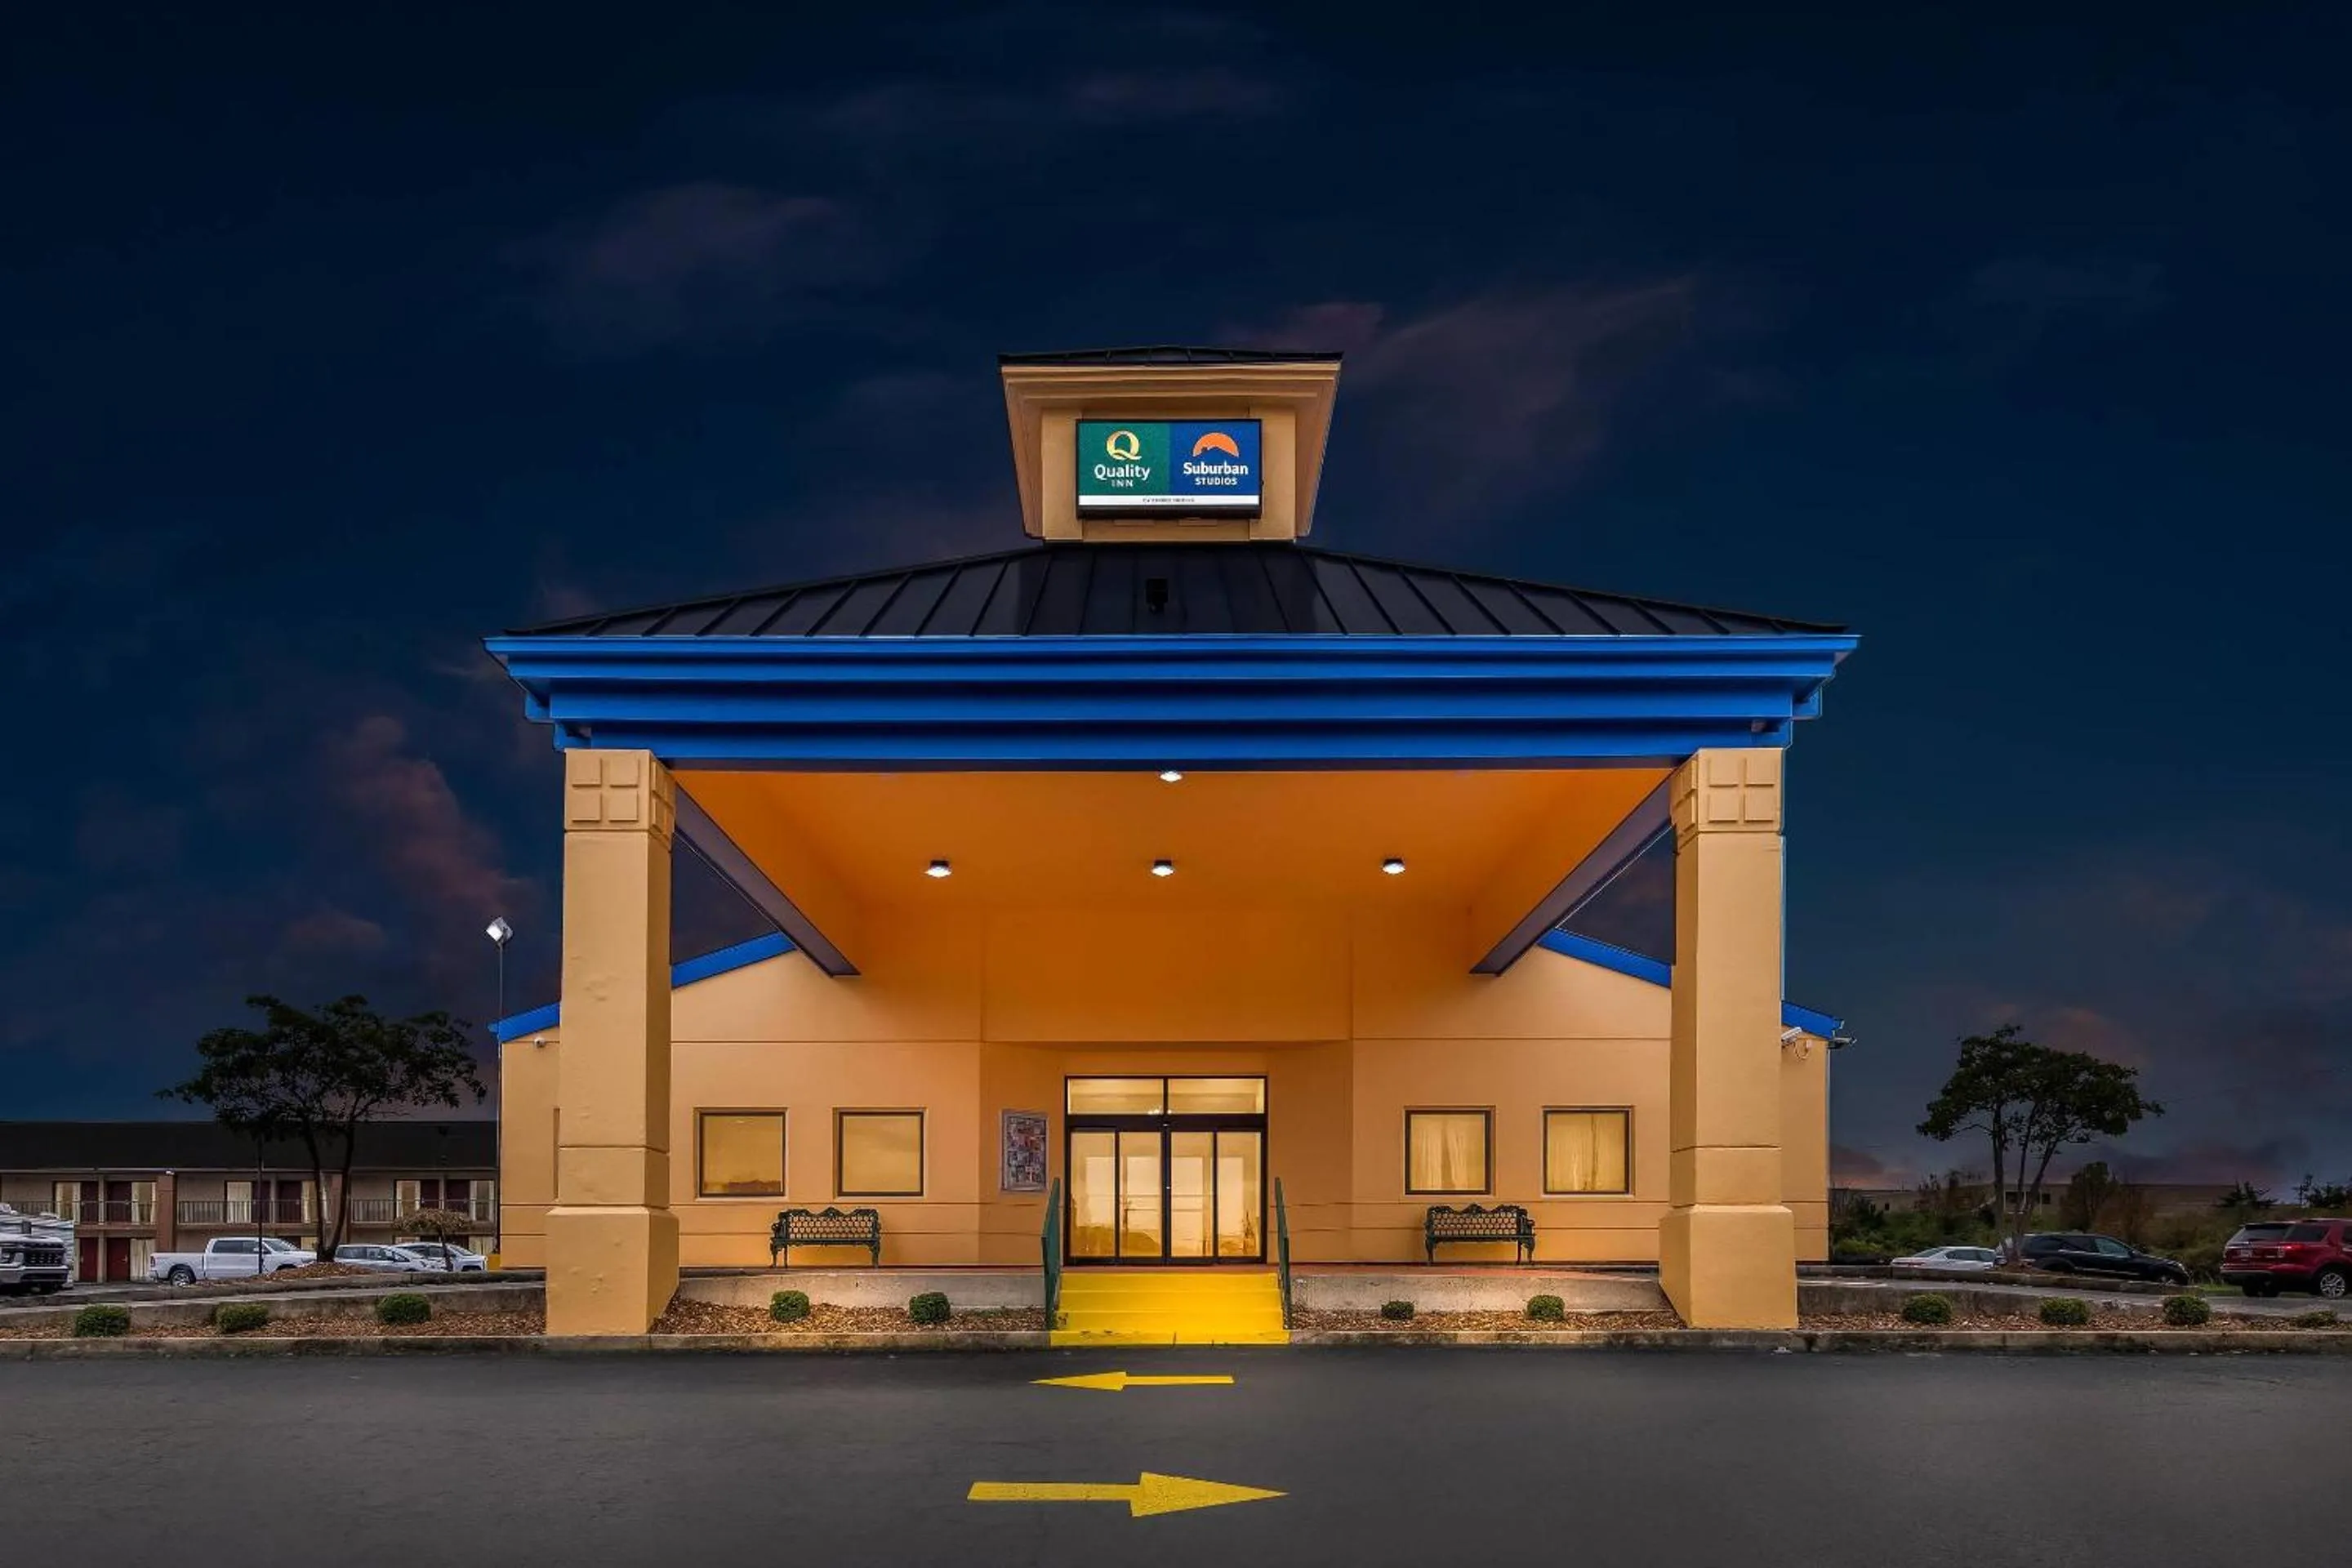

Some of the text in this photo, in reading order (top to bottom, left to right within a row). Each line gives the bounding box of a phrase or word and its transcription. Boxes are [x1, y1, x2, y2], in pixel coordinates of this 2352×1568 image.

[1094, 464, 1150, 481] Quality
[1183, 461, 1249, 475] Suburban
[1111, 479, 1134, 488] INN
[1195, 477, 1237, 485] STUDIOS
